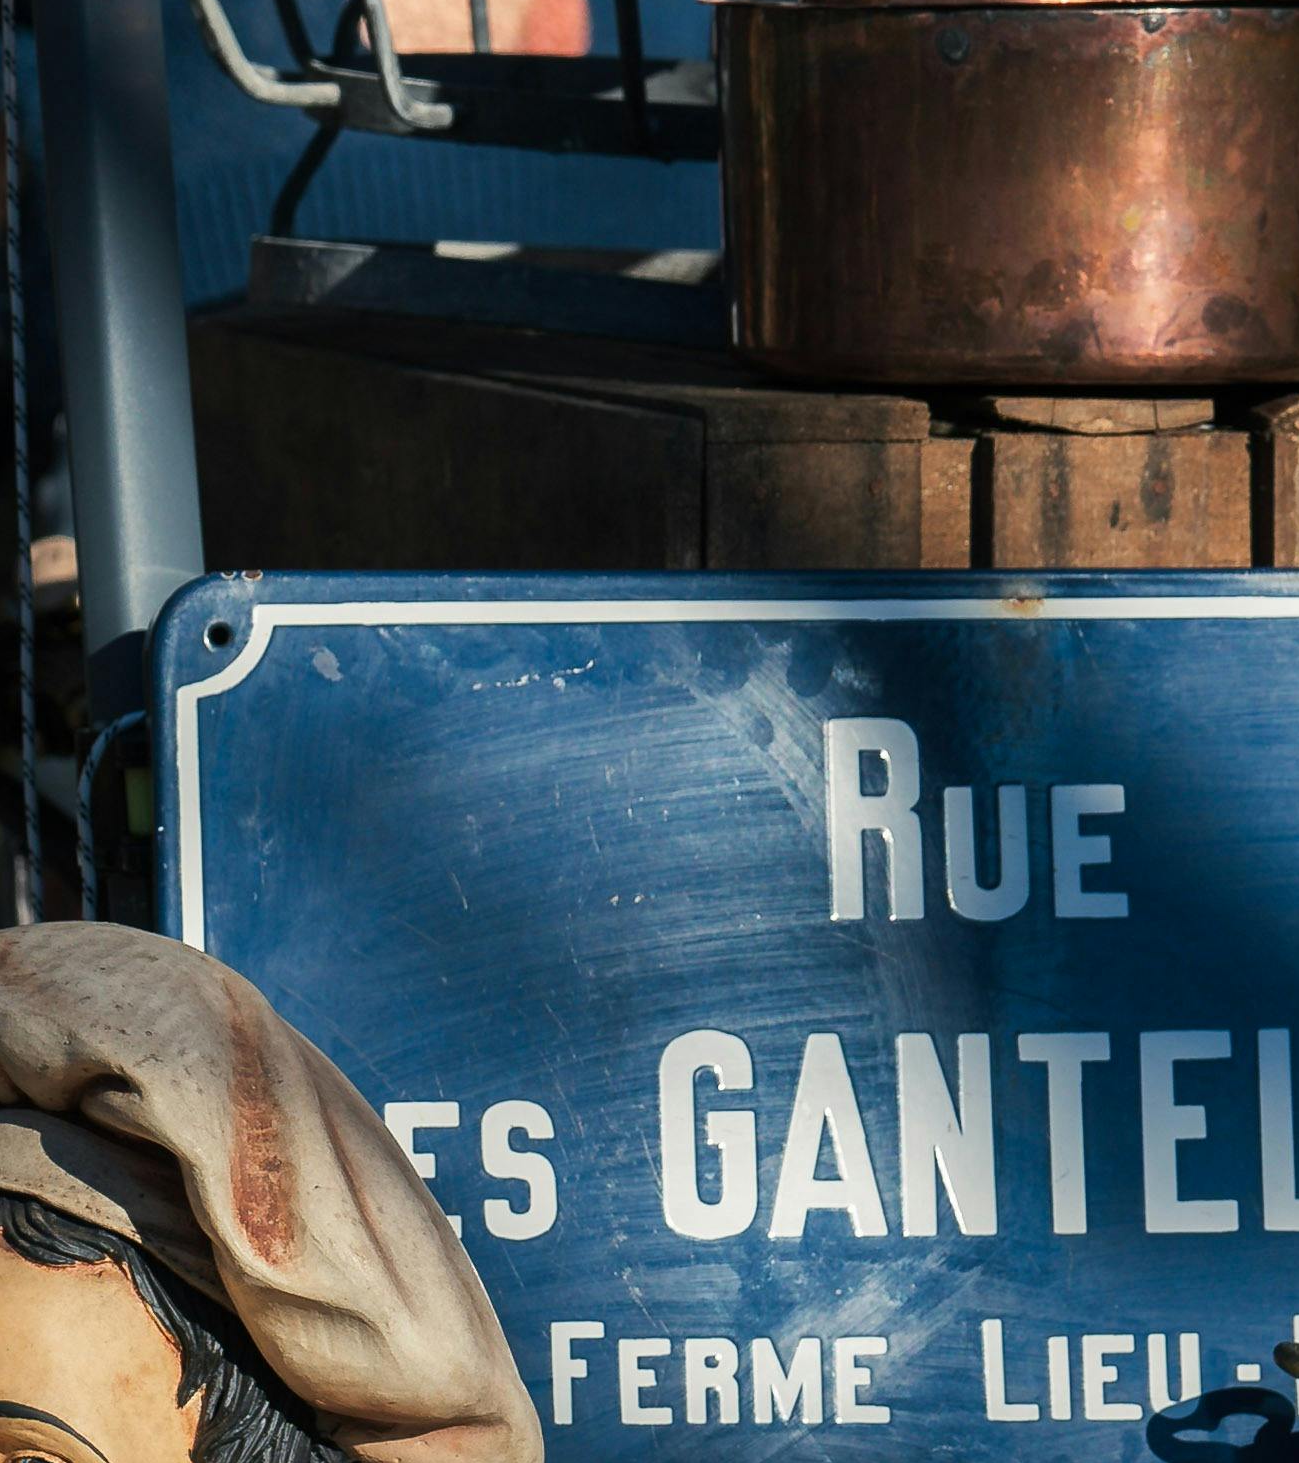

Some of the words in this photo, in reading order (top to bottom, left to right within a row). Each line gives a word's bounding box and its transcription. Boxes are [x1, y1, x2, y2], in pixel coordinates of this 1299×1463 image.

[825, 717, 1129, 921] RUE
[384, 1100, 559, 1240] ES
[550, 1321, 890, 1425] FERME
